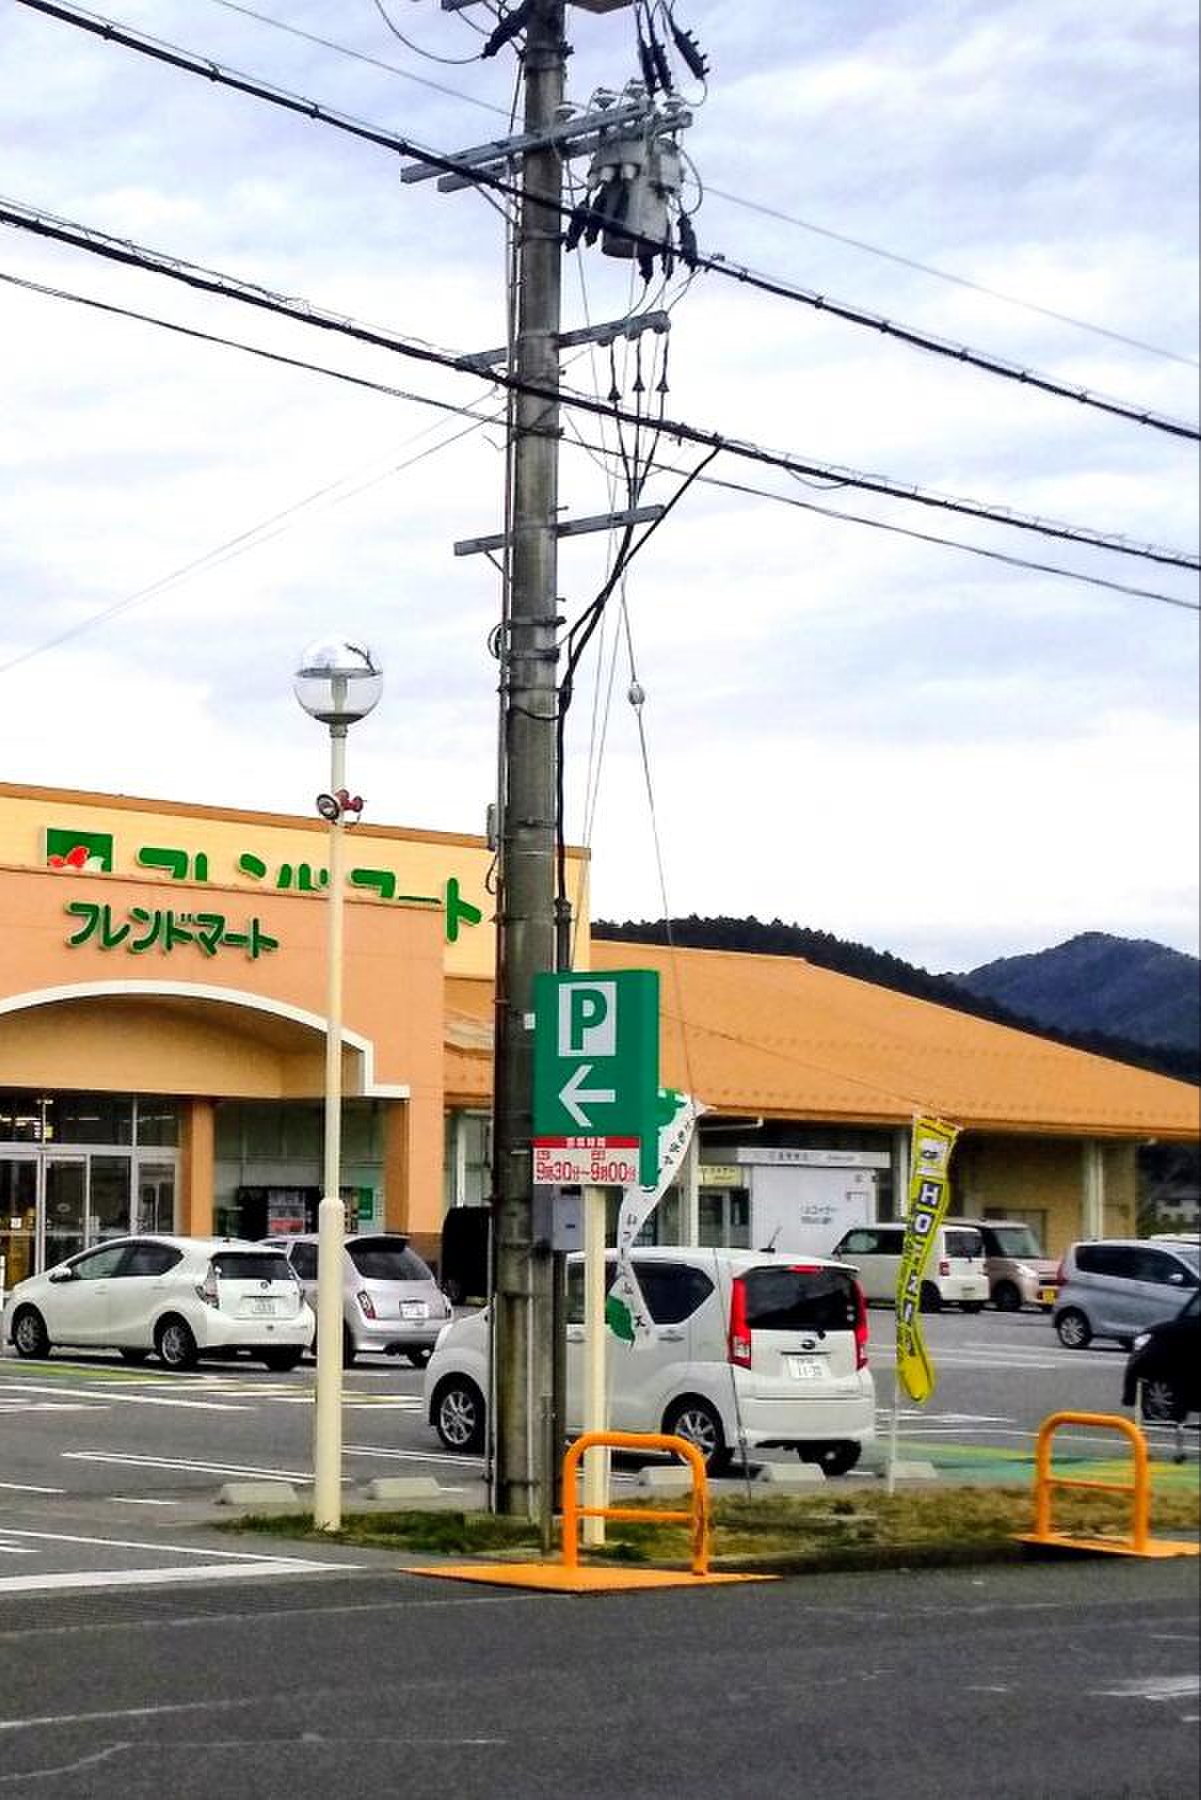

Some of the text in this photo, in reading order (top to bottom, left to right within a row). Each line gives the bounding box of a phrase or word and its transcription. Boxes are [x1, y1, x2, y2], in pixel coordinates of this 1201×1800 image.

[65, 901, 279, 959] フレンドマート
[570, 987, 607, 1051] P
